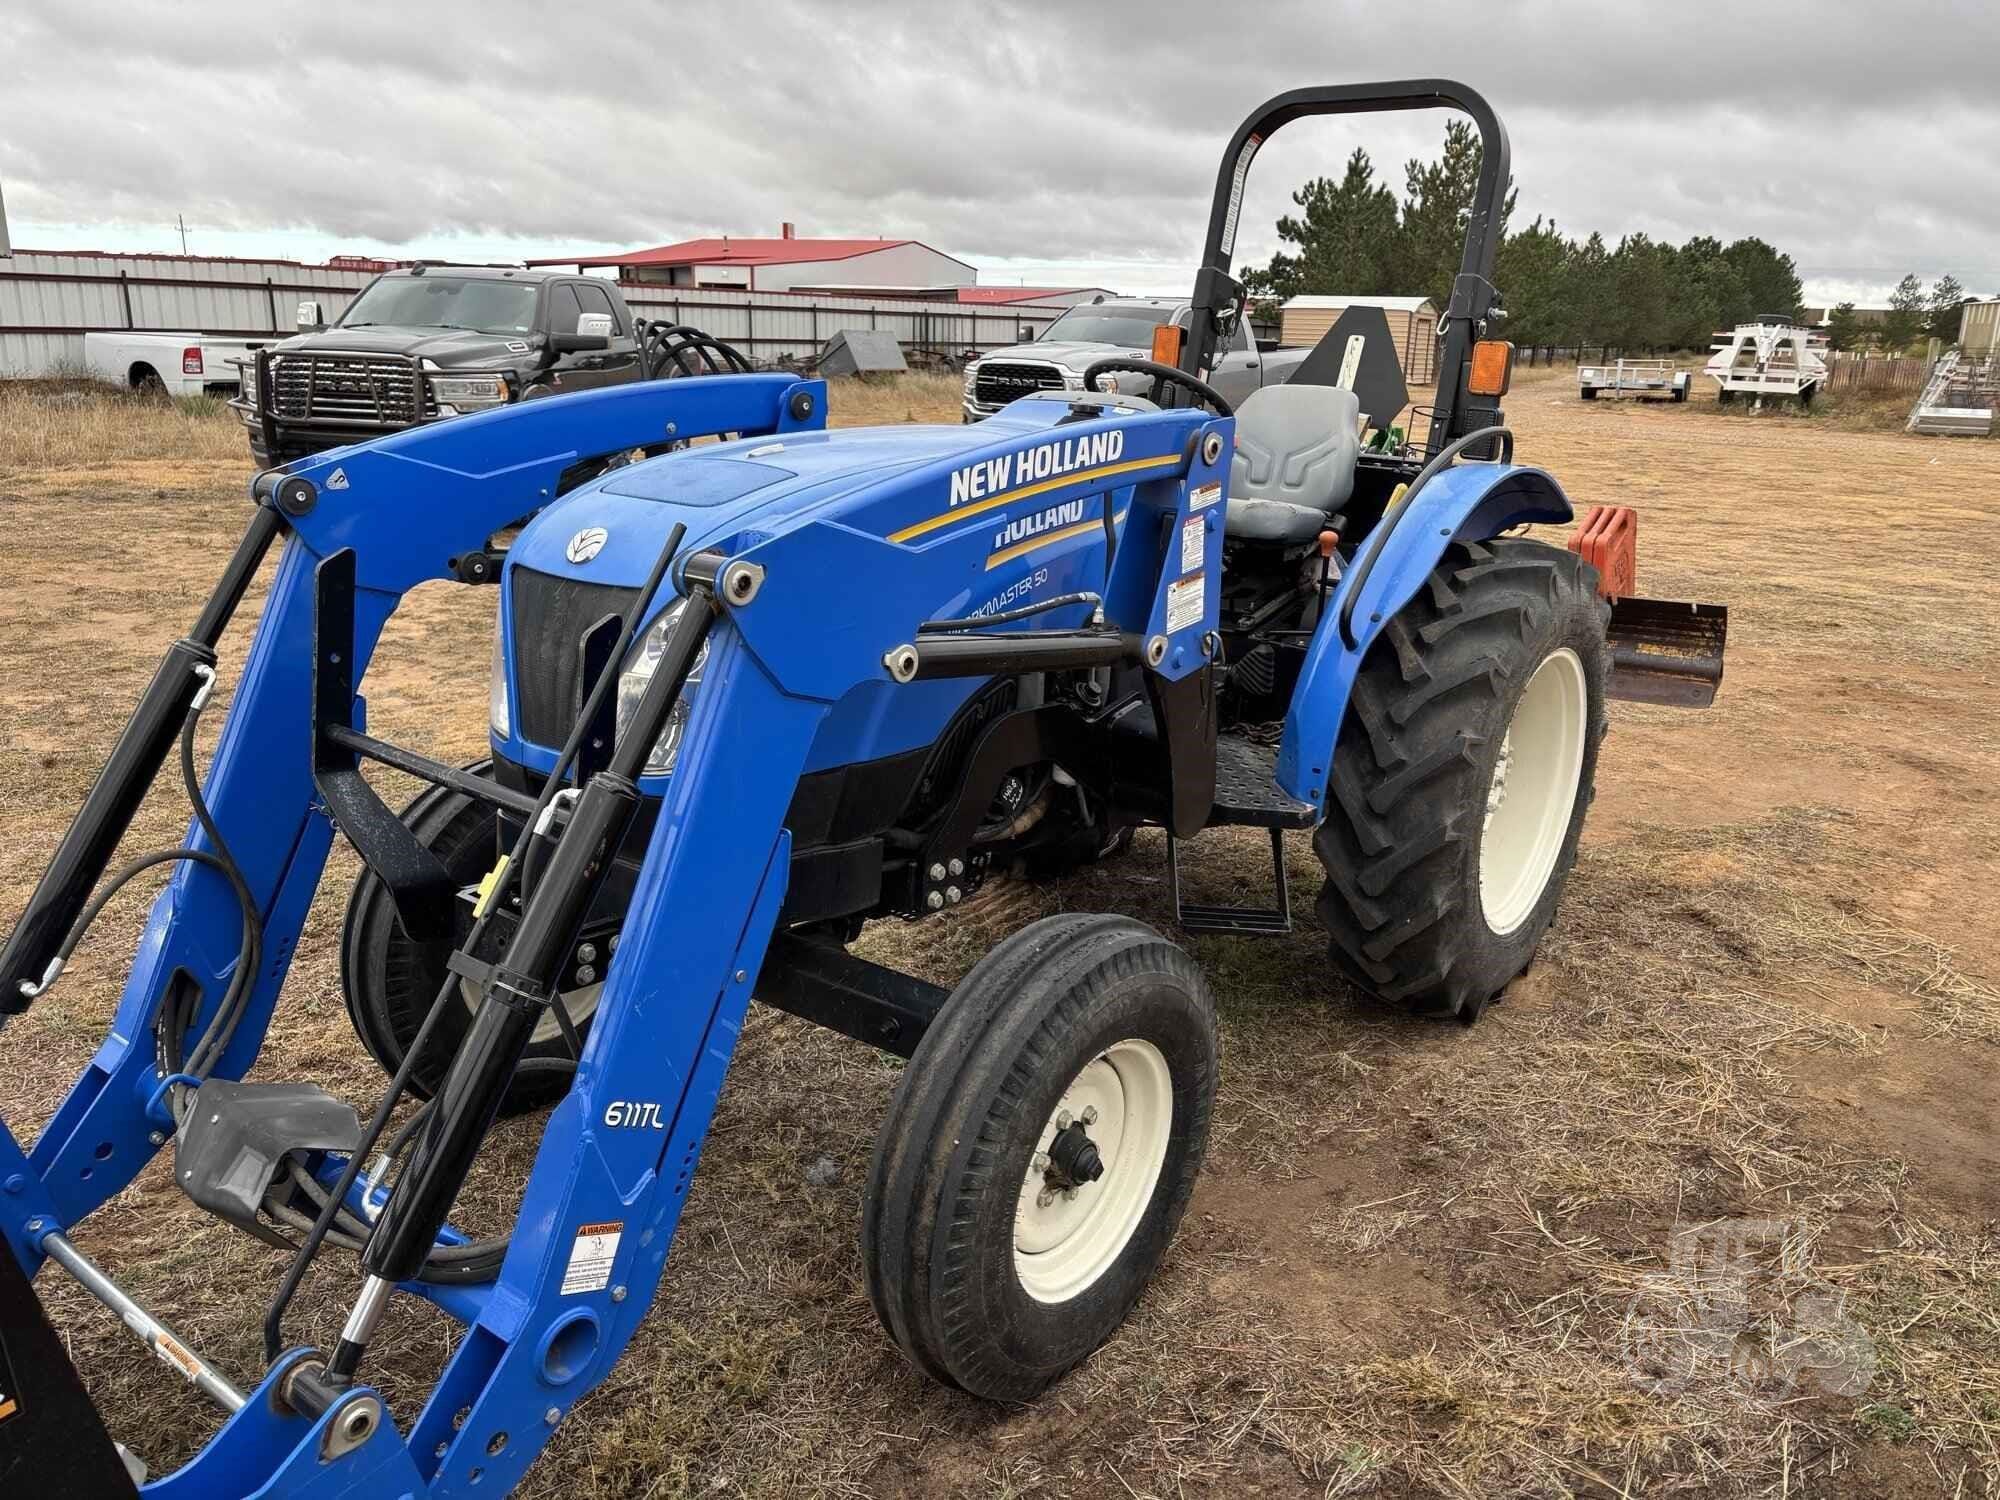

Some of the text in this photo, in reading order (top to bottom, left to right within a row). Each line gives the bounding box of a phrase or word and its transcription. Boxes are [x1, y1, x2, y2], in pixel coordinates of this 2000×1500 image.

[998, 376, 1035, 387] RAM
[950, 429, 1124, 507] NEW HOLLAND
[1034, 567, 1049, 588] 50
[604, 1100, 665, 1129] 611TL
